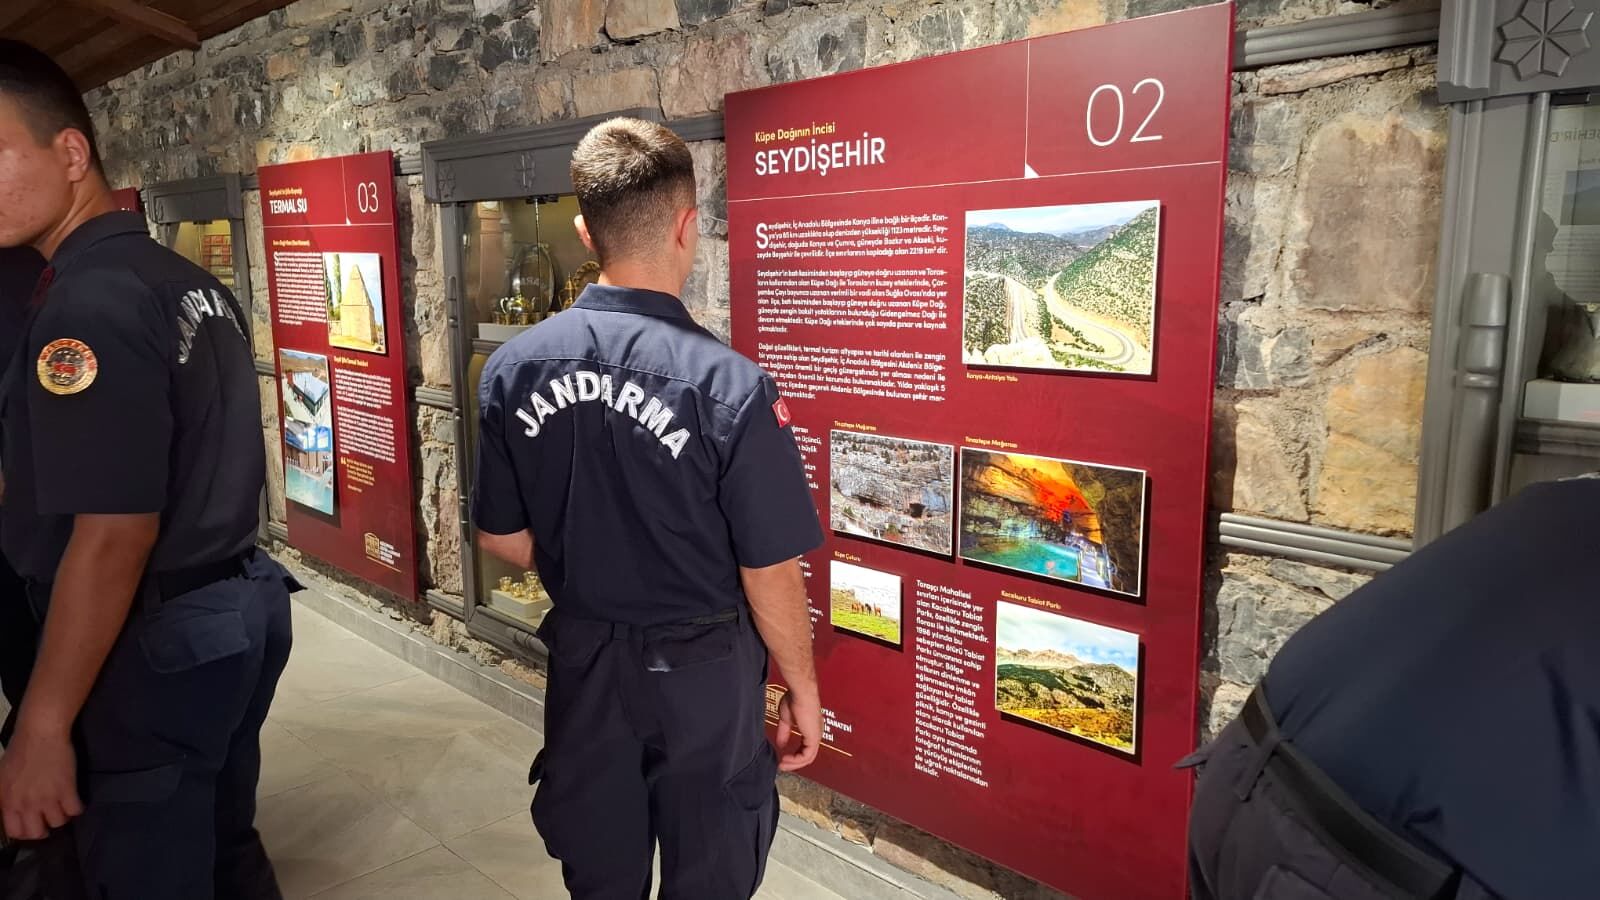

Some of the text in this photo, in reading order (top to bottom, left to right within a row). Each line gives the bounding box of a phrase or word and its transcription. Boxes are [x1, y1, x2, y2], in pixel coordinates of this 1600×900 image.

[755, 121, 836, 144] Küpe Dağının İncisi
[1087, 78, 1164, 146] 02
[755, 132, 886, 176] SEYDİŞEHİR
[270, 197, 308, 214] TERMAL SU
[358, 182, 378, 212] 03
[176, 288, 246, 363] JANDAR
[515, 370, 690, 460] JANDARMA
